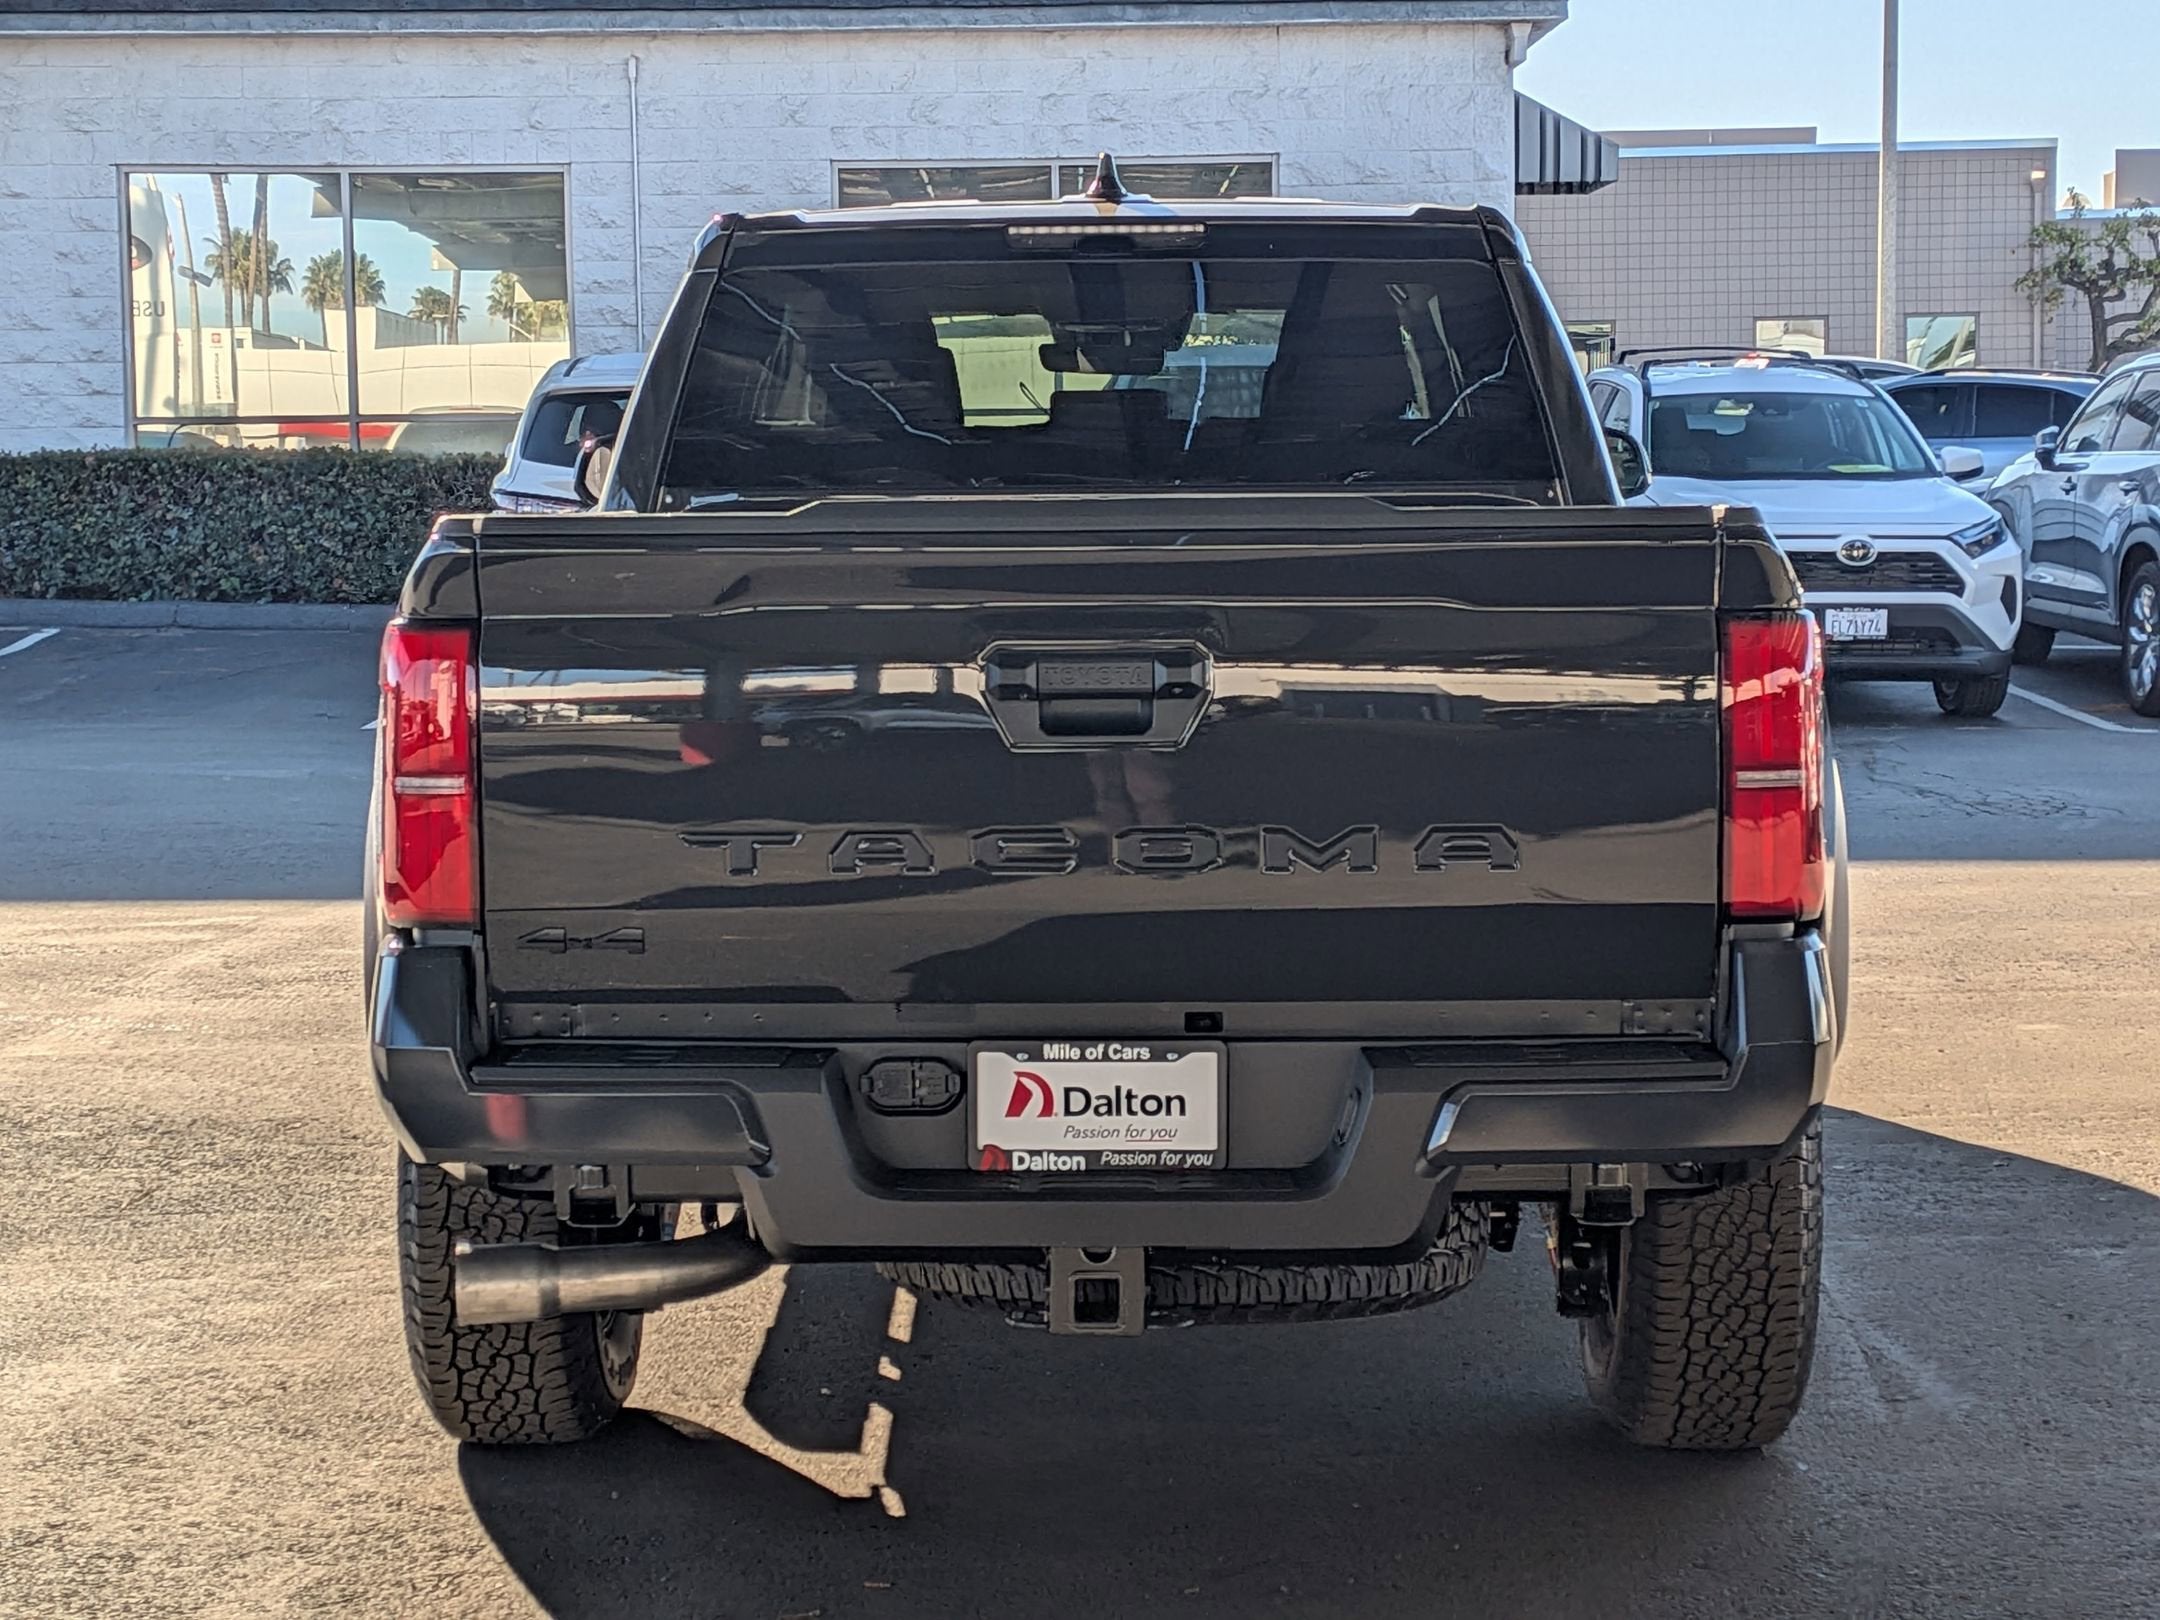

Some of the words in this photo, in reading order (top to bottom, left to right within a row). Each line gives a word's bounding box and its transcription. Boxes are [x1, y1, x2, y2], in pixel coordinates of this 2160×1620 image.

[1043, 665, 1148, 686] TOYOTA
[677, 824, 1520, 876] TACOMA
[1043, 1043, 1082, 1060] Mile
[1085, 1043, 1106, 1060] of
[1107, 1043, 1151, 1061] Cars
[1062, 1085, 1187, 1117] Dalton
[1063, 1125, 1120, 1139] Passion
[1123, 1124, 1148, 1140] for
[1149, 1127, 1178, 1141] you
[1011, 1151, 1086, 1171] Dalton
[1099, 1151, 1158, 1167] Passion
[1160, 1151, 1182, 1167] for
[1183, 1153, 1214, 1170] you
